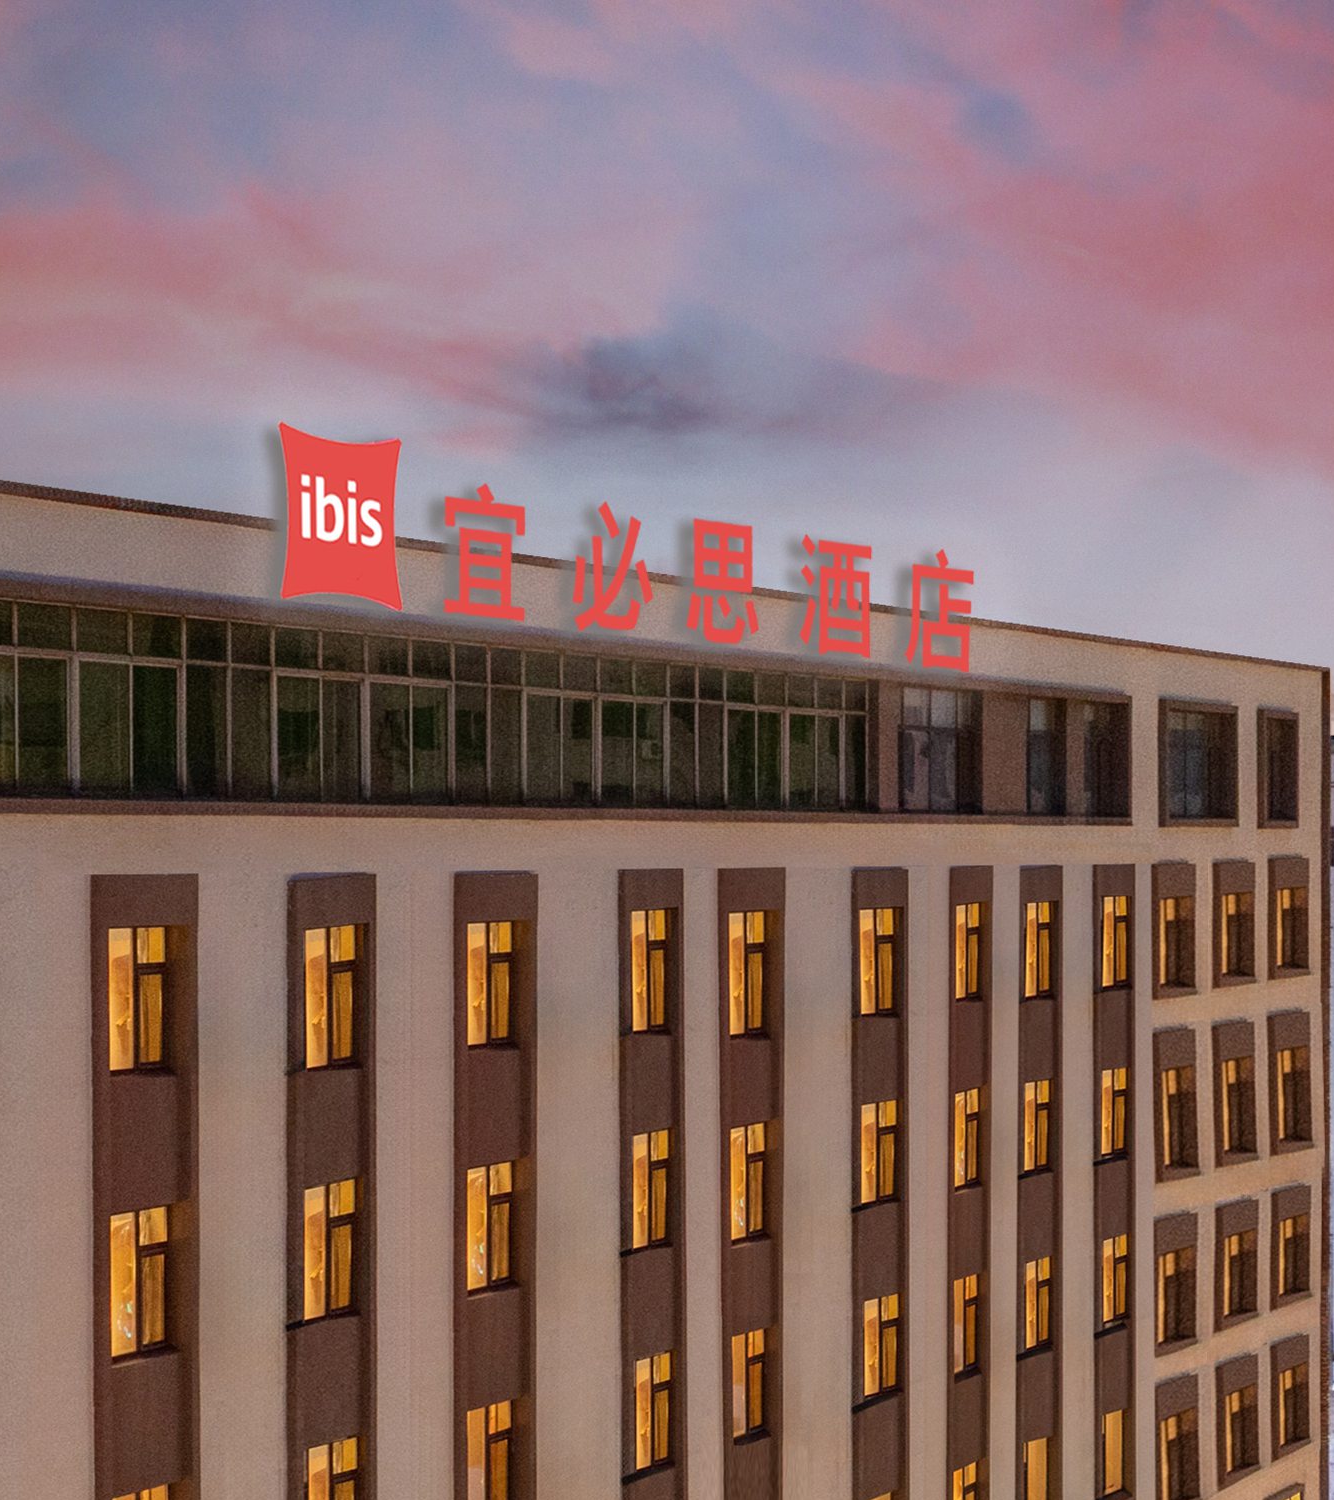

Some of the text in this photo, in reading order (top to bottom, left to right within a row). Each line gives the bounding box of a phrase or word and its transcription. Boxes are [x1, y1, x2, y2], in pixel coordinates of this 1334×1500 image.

[299, 474, 383, 548] ibis
[443, 483, 975, 673] 宜必思酒店
